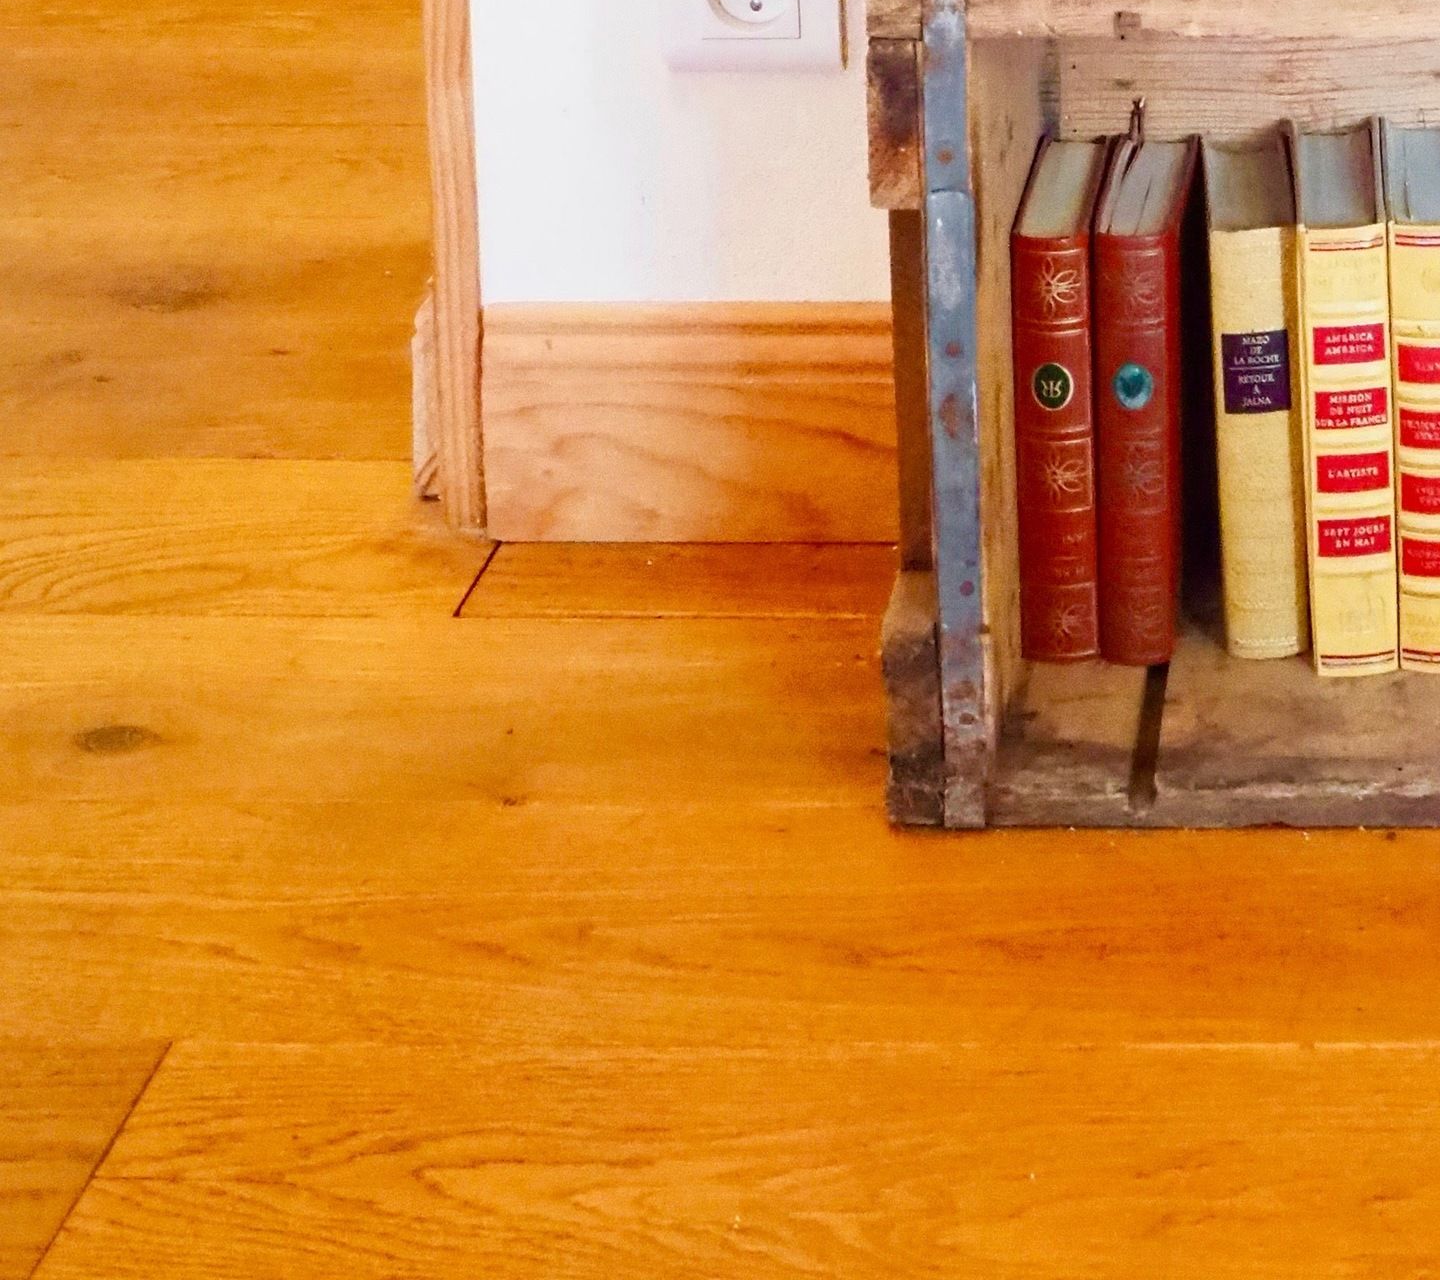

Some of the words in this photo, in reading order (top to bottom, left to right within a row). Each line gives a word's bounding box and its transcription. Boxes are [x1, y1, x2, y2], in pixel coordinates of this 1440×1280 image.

[1234, 356, 1246, 366] LA
[1247, 354, 1280, 364] ROCHE
[1238, 374, 1275, 384] RETOUR
[1242, 396, 1272, 407] JALNA
[1350, 414, 1387, 426] FRANCE
[1353, 524, 1385, 536] JOURS
